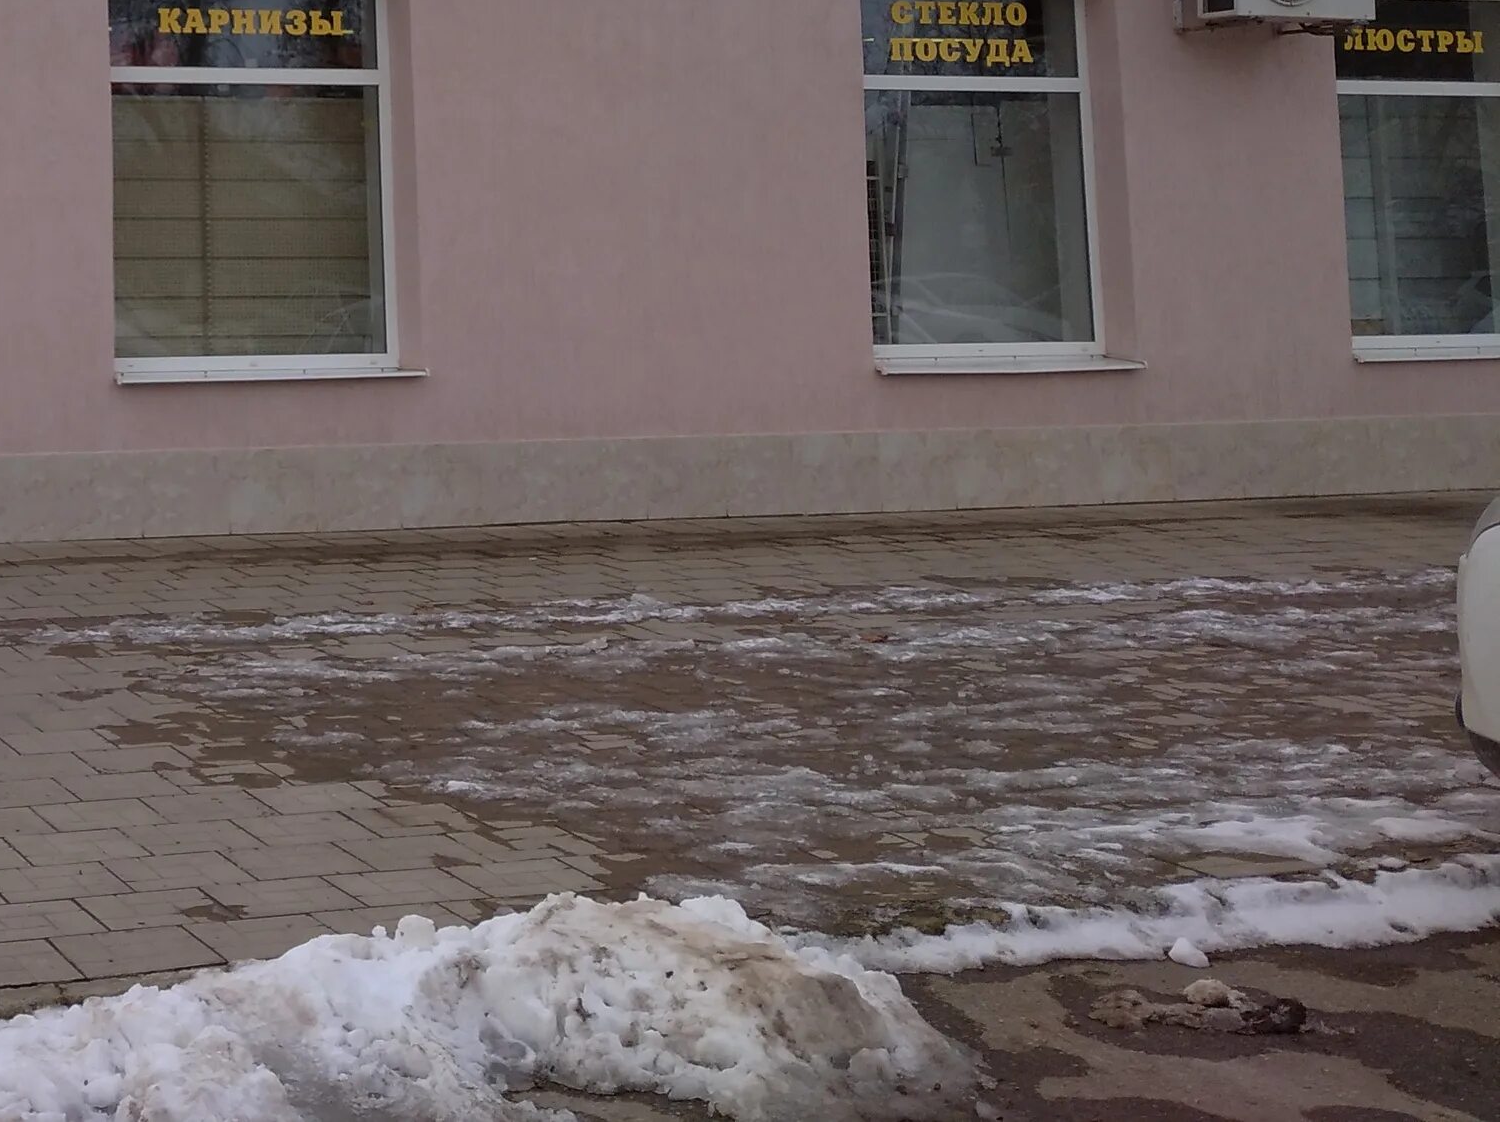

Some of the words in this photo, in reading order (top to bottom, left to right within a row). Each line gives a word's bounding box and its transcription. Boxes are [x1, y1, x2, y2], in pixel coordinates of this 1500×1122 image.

[158, 7, 344, 36] КАРНИЗЫ
[890, 0, 1028, 27] СТЕКЛО
[890, 37, 1034, 67] ПОСУДА
[1344, 28, 1485, 54] ЛЮСТРЫ
